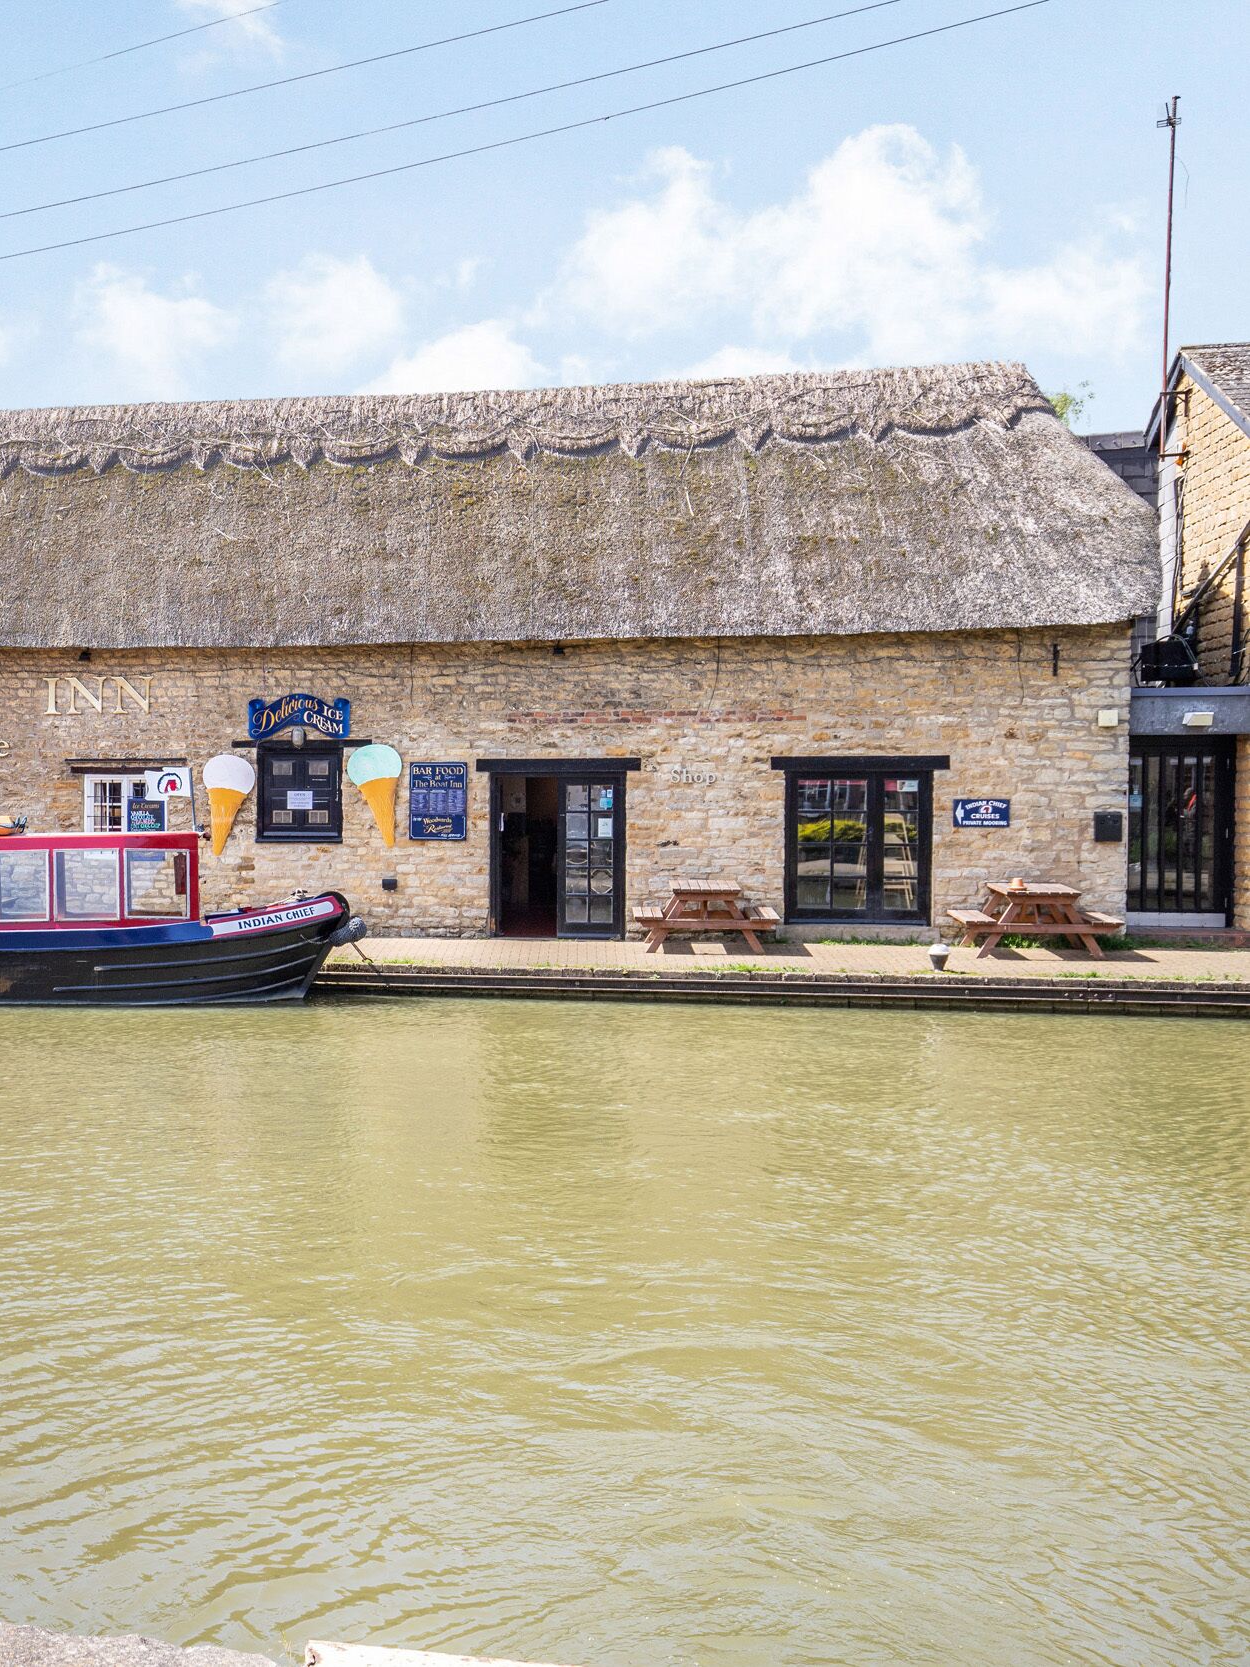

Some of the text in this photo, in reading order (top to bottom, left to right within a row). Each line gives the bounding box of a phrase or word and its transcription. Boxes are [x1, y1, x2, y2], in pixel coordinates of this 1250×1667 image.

[42, 675, 153, 715] INN
[252, 695, 319, 735] Delicious
[322, 704, 344, 720] ICE
[303, 710, 344, 734] CREAM
[413, 766, 463, 775] BAR FOOD
[671, 768, 717, 786] Shop
[414, 780, 463, 788] The Boat Inn
[965, 800, 1007, 810] INDIAN CHIEF
[238, 906, 316, 930] INDIAN CHIEF
